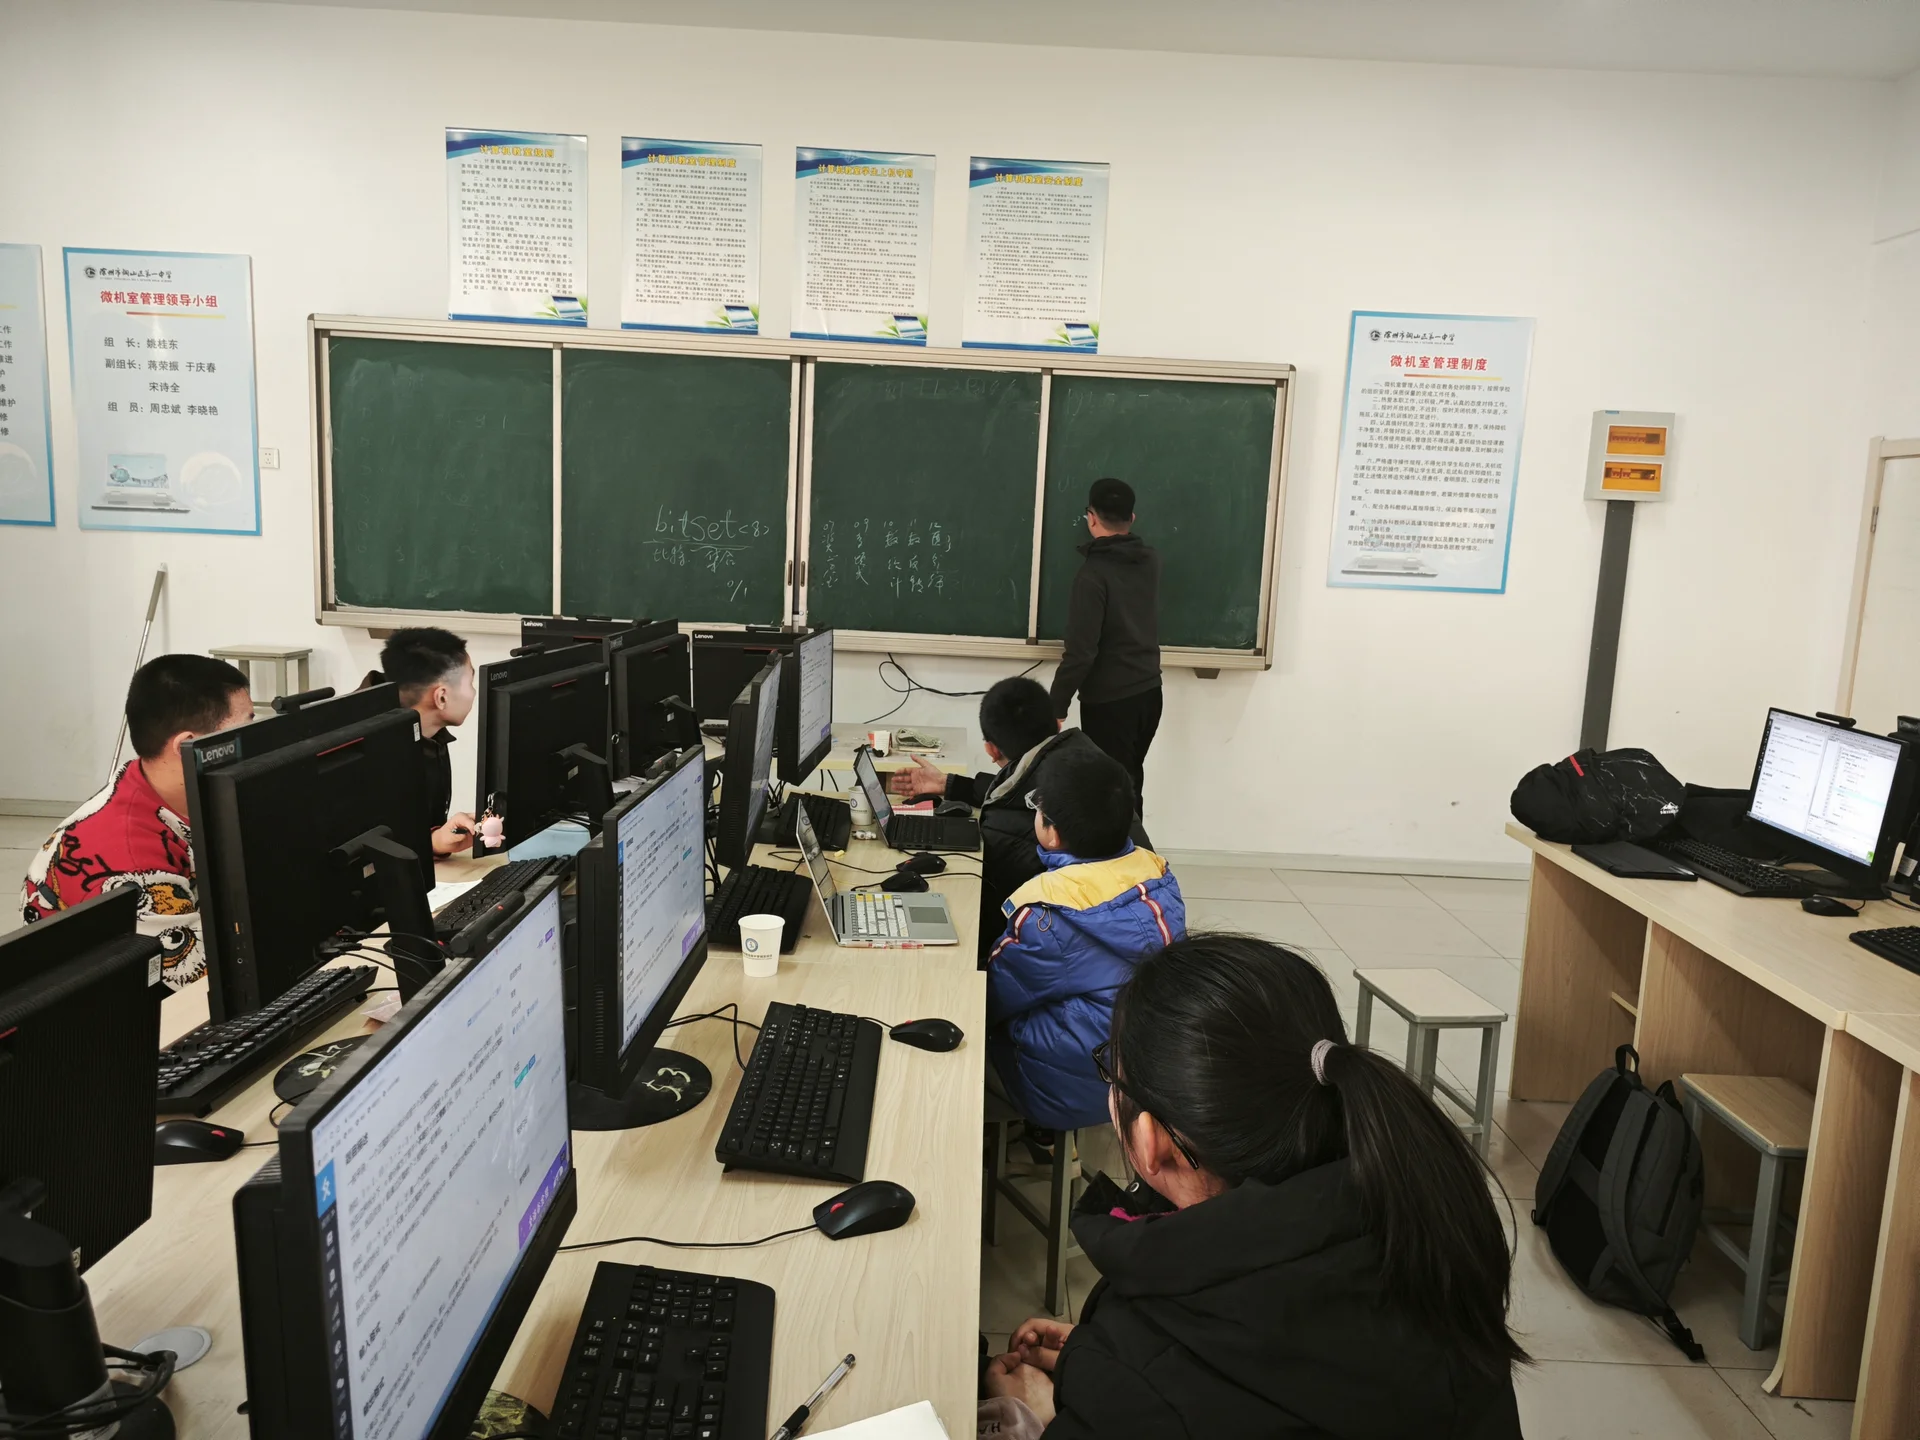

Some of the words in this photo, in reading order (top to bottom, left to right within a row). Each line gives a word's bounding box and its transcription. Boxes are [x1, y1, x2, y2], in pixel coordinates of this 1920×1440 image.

[100, 290, 218, 308] 微机室管理领导小组
[1390, 355, 1488, 371] 微机室管理制度
[149, 382, 180, 393] 宋诗全
[523, 620, 544, 628] Lenovo
[490, 671, 508, 681] Lenovo
[200, 744, 235, 763] Lenovo
